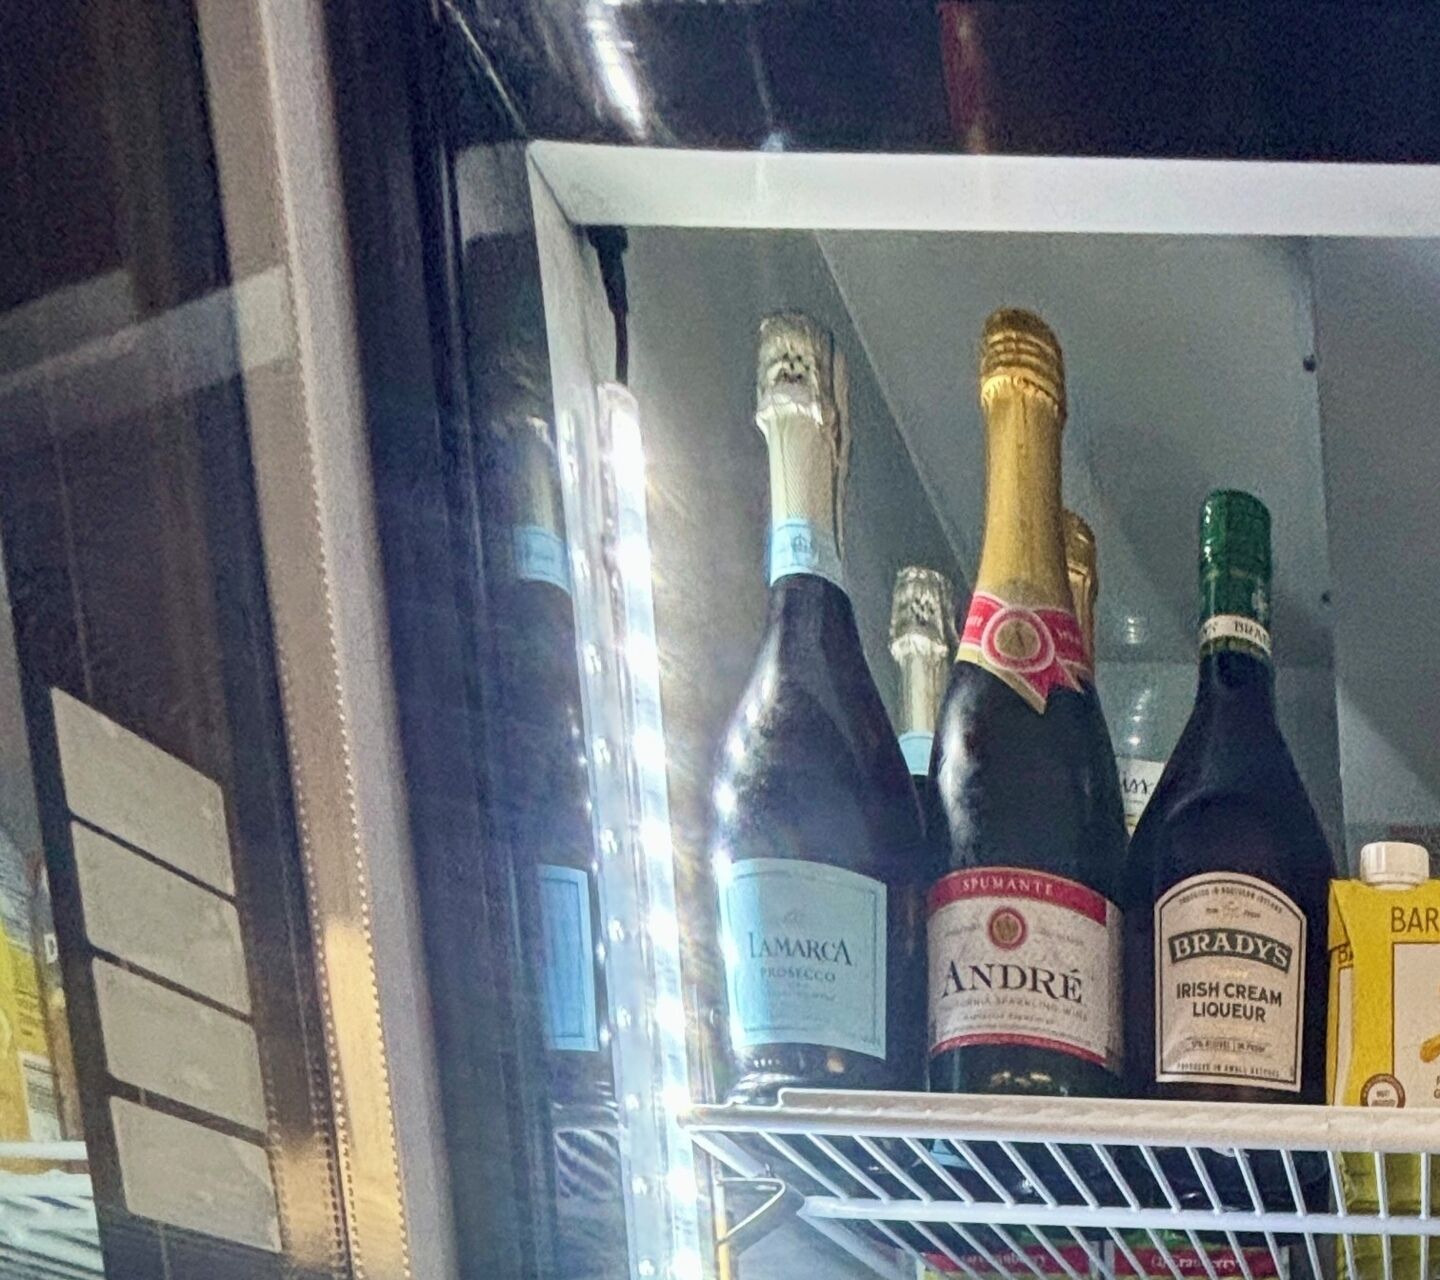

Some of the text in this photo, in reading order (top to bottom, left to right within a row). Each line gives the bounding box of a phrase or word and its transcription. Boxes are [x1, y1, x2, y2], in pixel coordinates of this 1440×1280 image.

[962, 876, 1053, 895] SPUMANTE
[1172, 931, 1288, 968] BRADY'S
[761, 966, 836, 982] PROSECCO
[941, 959, 1083, 1004] ANDRÉ
[1176, 981, 1282, 1007] IRISH CREAM
[1193, 1001, 1266, 1023] LIQUEUR
